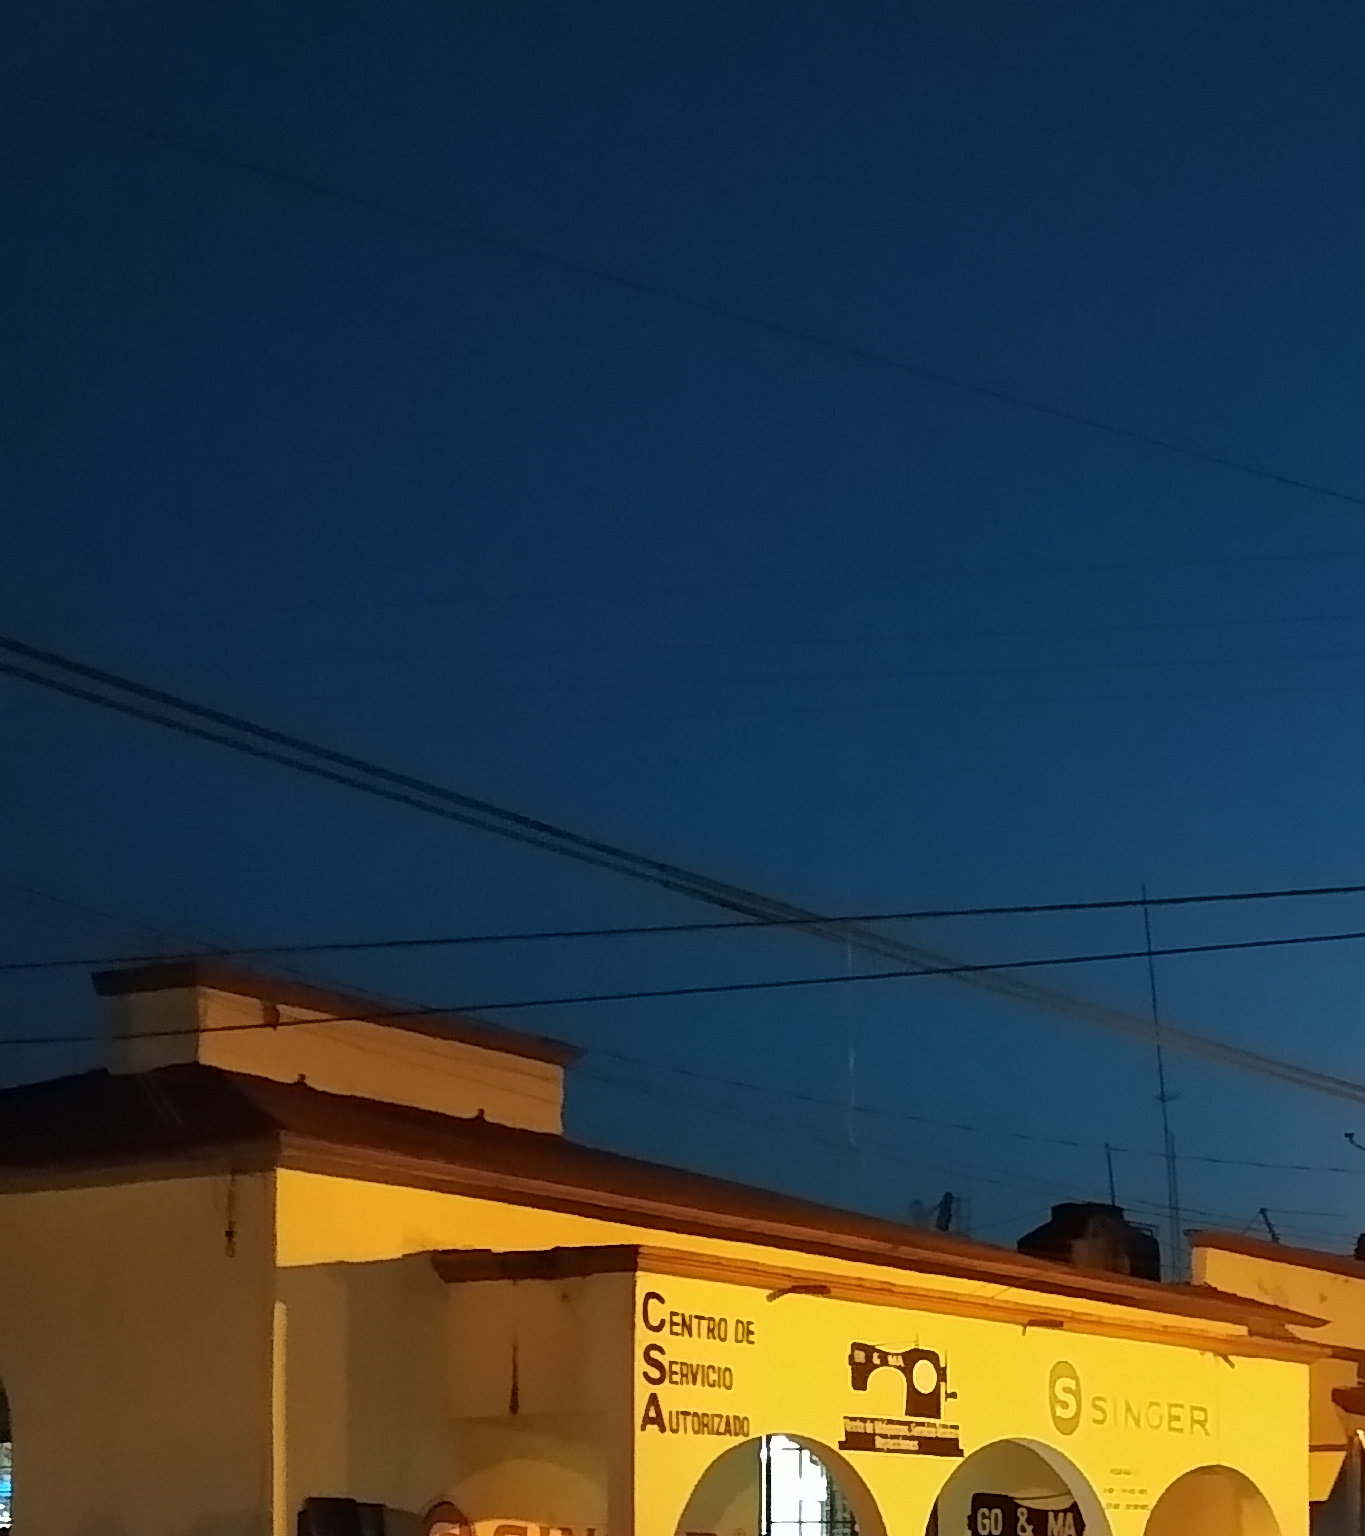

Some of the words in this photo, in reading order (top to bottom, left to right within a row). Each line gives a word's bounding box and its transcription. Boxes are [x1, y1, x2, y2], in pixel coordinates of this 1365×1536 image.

[642, 1291, 728, 1343] CENTRO
[734, 1318, 756, 1346] DE
[642, 1342, 734, 1391] SERVICIO
[640, 1392, 750, 1438] AUTORIZADO
[1090, 1395, 1212, 1437] SINGER
[976, 1507, 1003, 1536] GO
